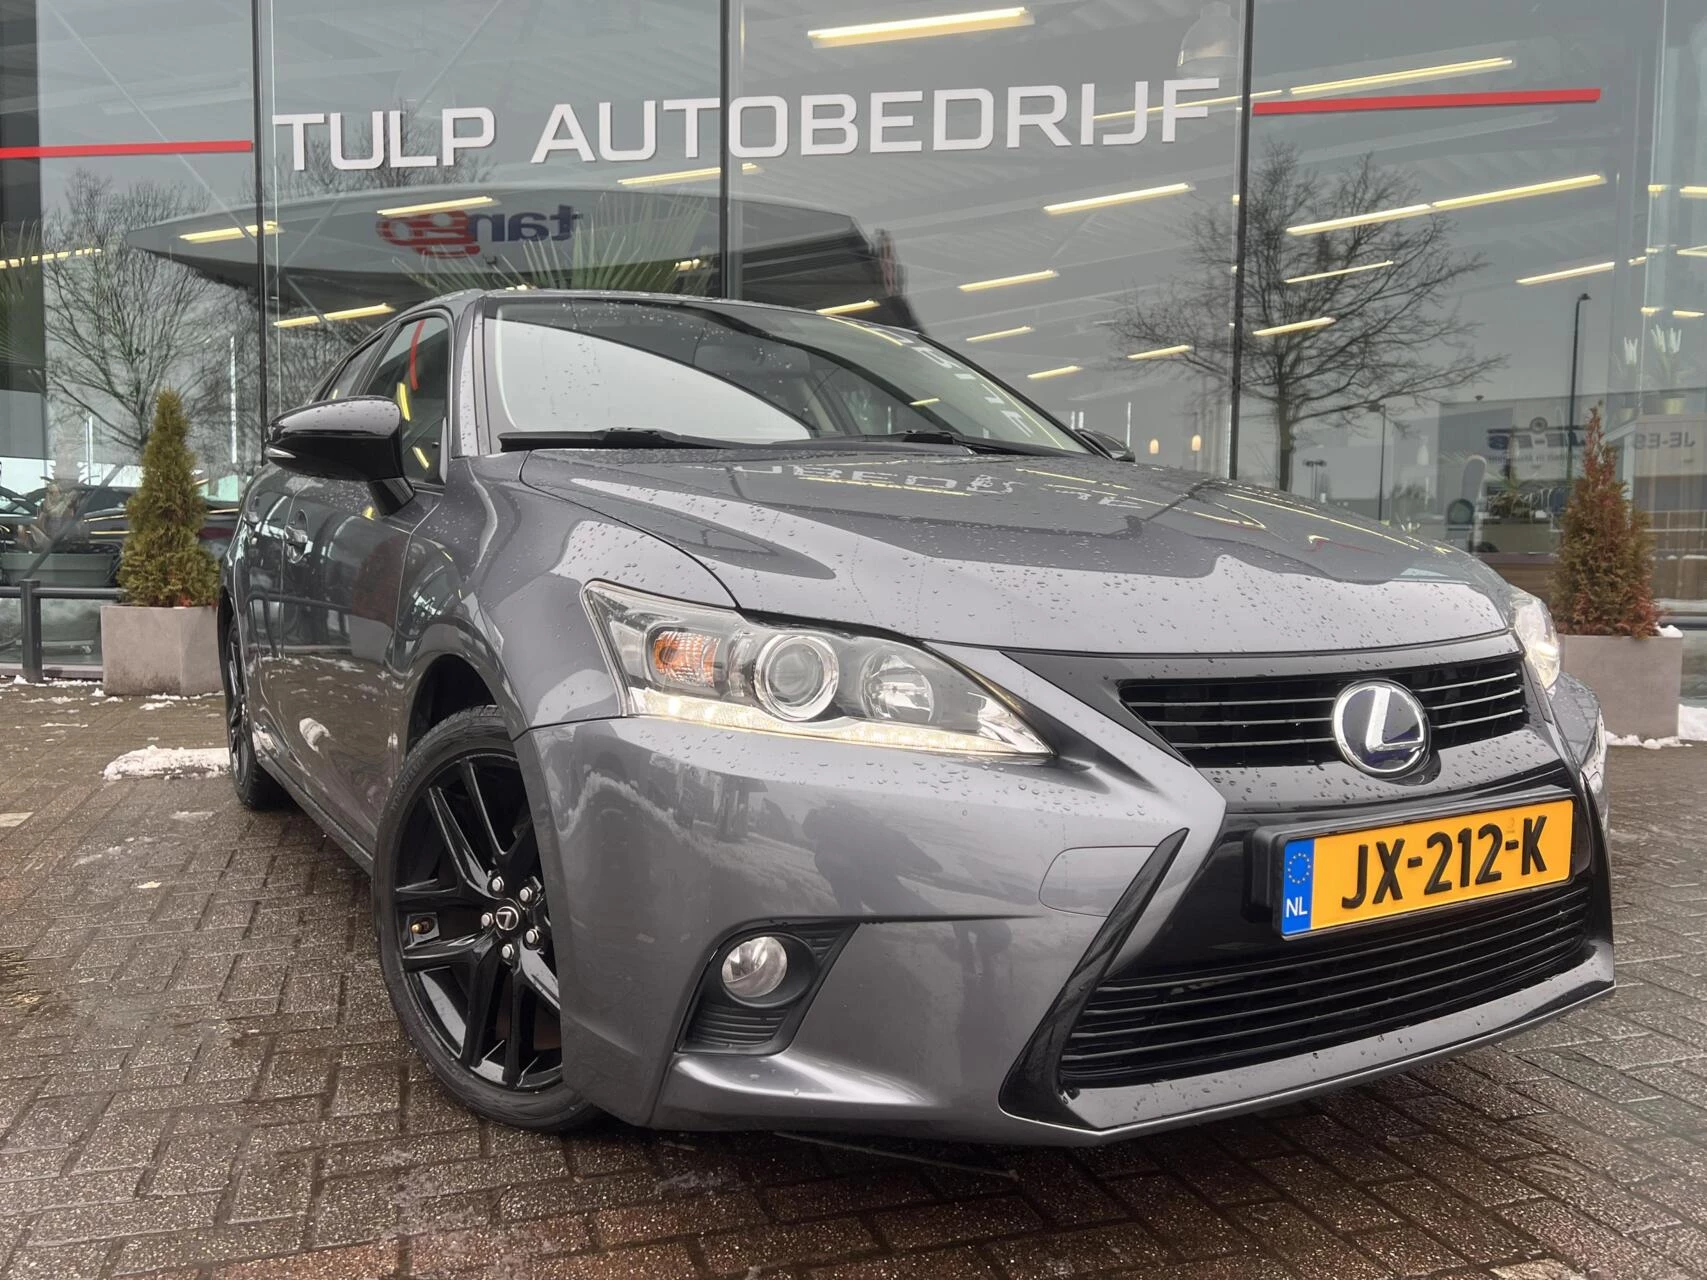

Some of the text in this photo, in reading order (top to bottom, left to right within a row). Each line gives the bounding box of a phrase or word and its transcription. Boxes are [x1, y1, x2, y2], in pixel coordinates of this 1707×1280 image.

[272, 77, 1220, 171] TULP AUTOBEDRIJF
[1285, 896, 1308, 918] NL
[1341, 815, 1548, 910] JX-212-K
